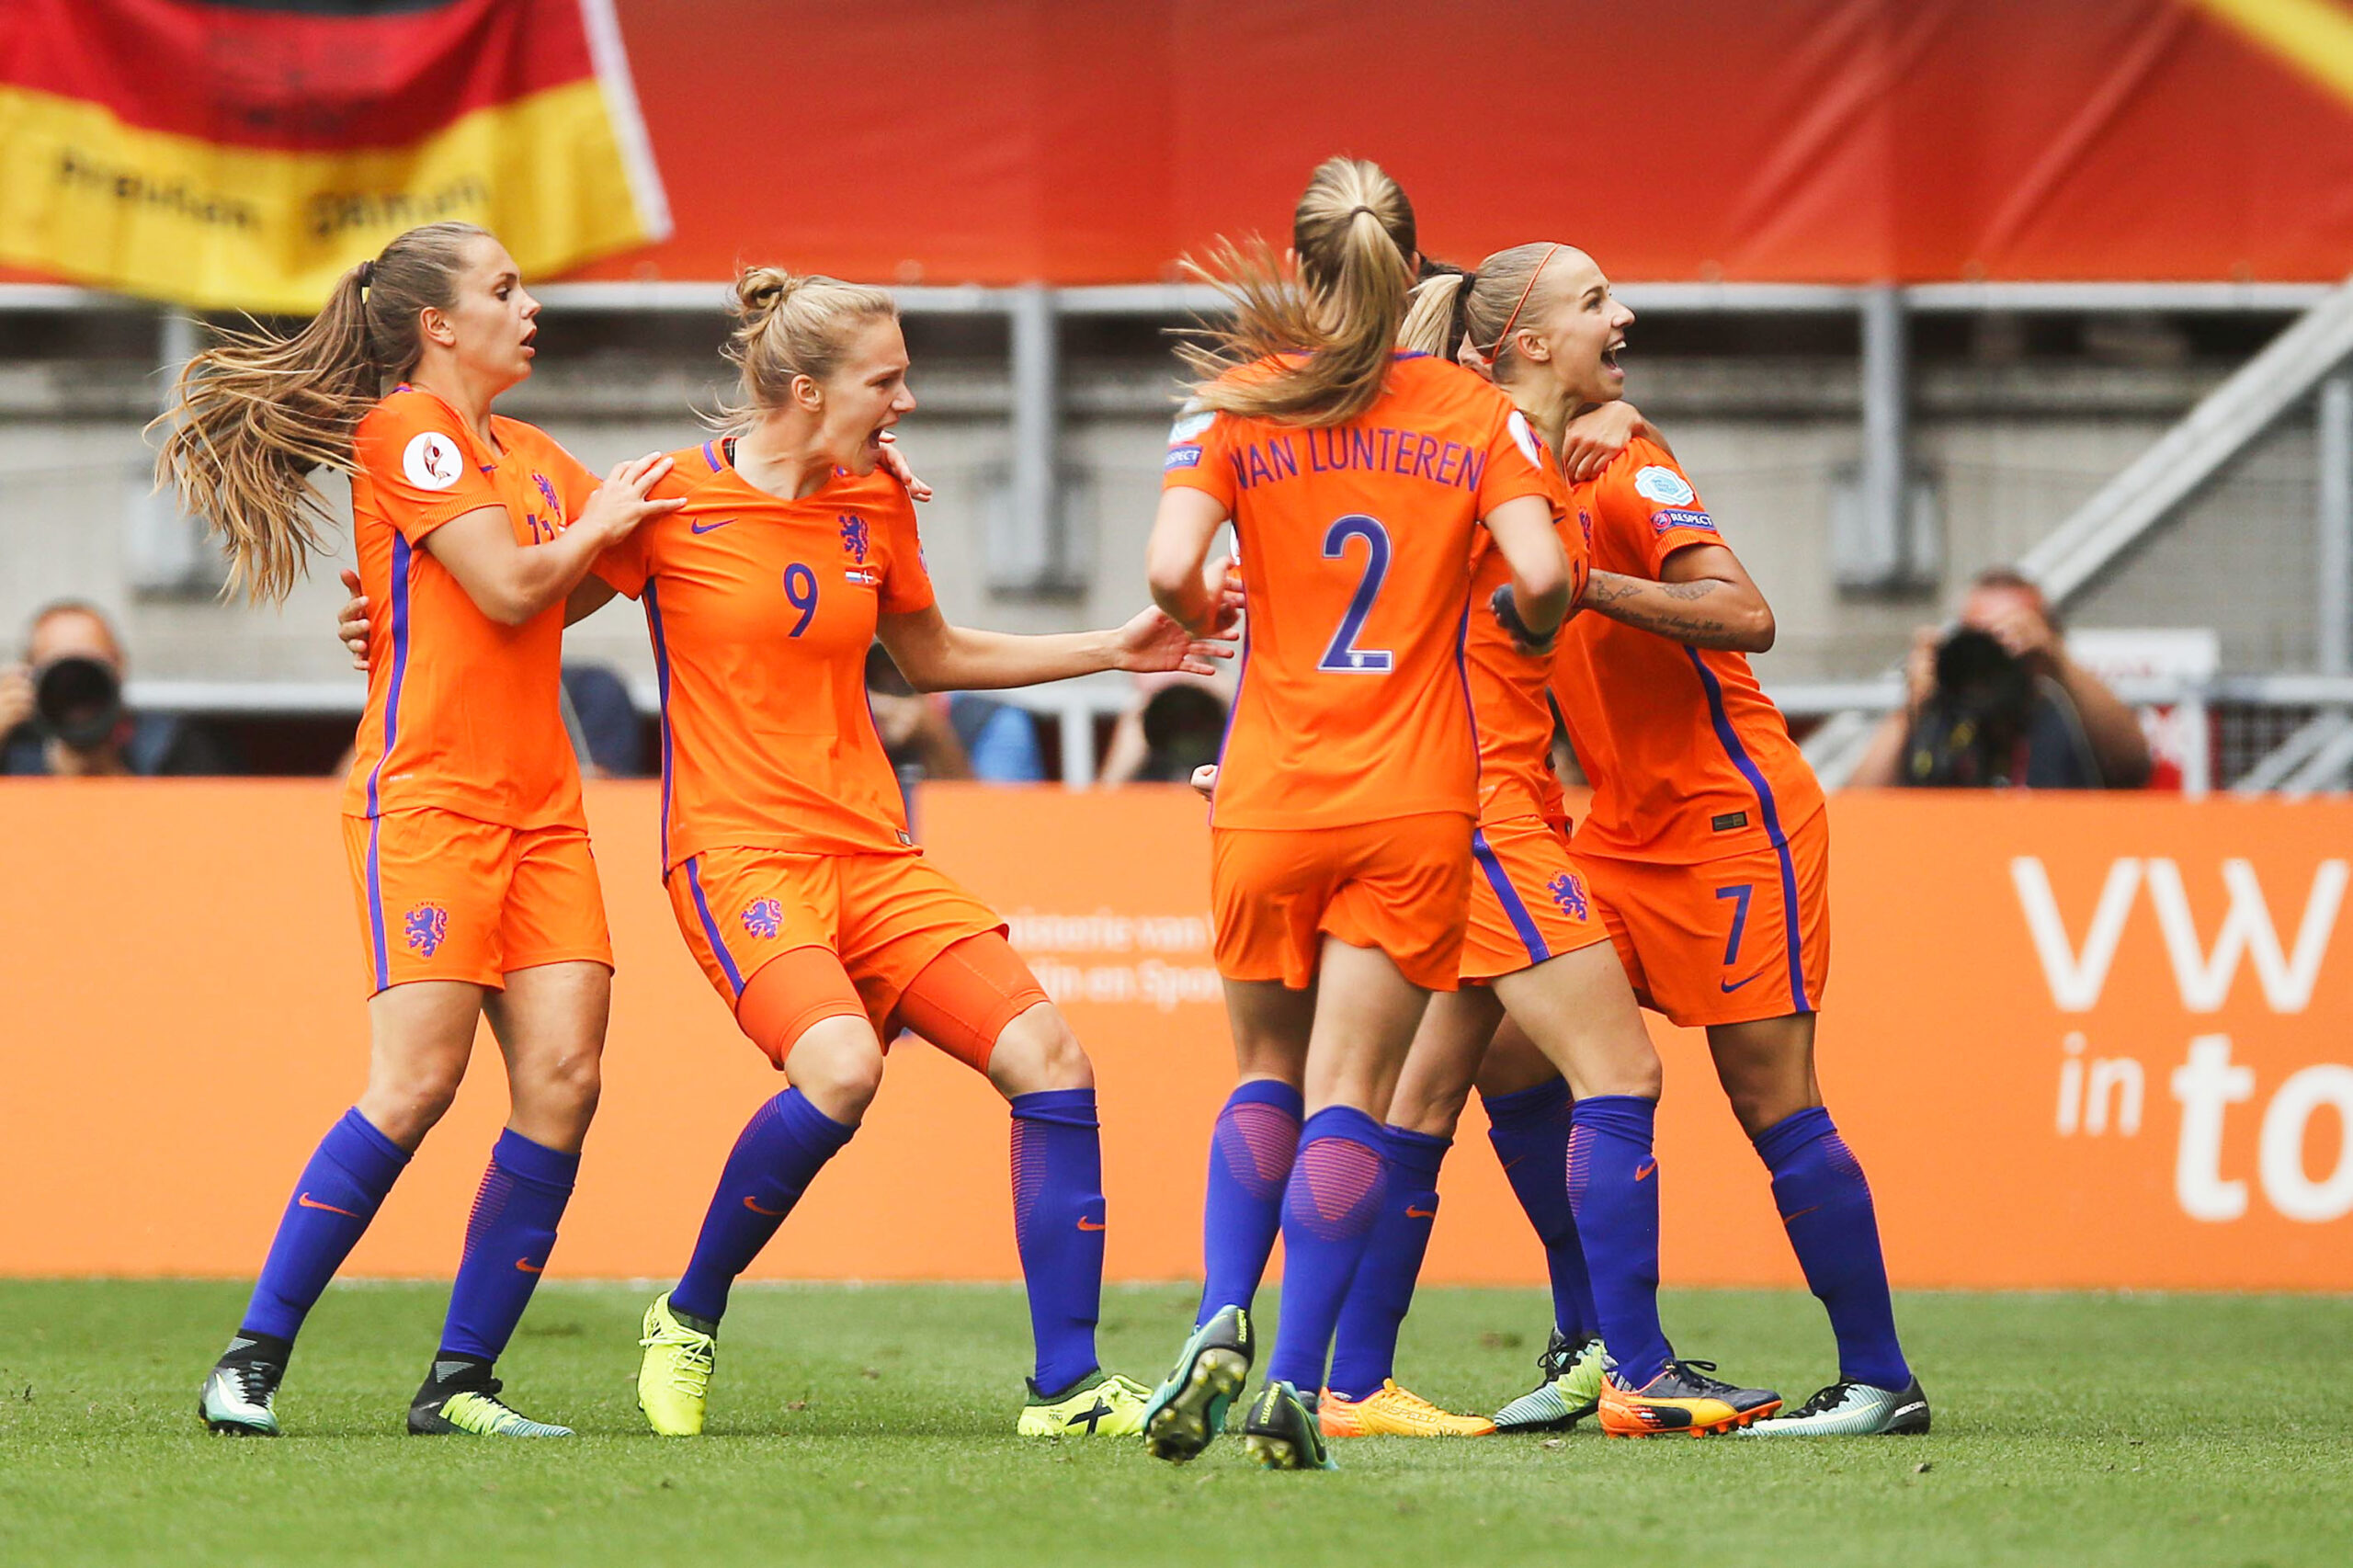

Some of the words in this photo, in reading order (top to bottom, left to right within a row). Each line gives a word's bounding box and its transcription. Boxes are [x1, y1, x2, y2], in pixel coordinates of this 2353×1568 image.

[1231, 437, 1299, 489] VAN
[1307, 427, 1486, 492] LUNTEREN
[1670, 513, 1713, 527] RESPECT
[784, 562, 818, 638] 9
[1317, 514, 1392, 672] 2
[1716, 884, 1753, 966] 7
[2056, 1031, 2144, 1137] in
